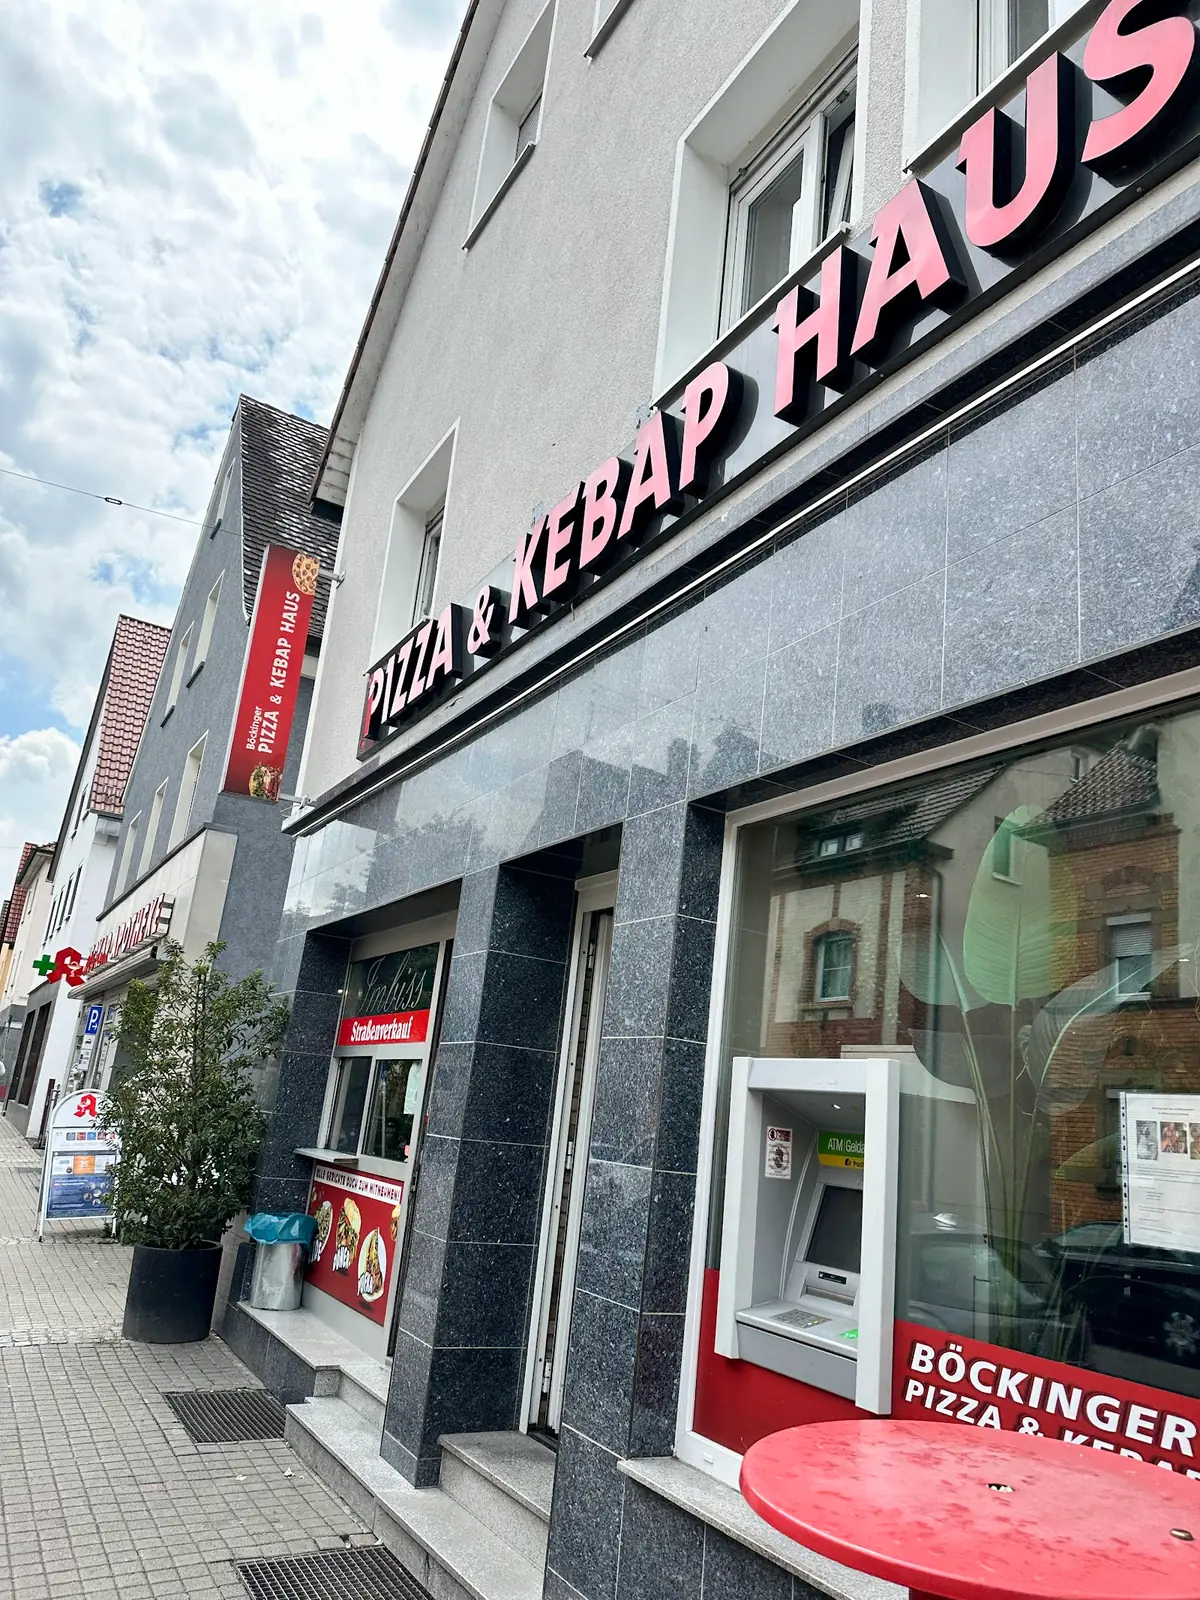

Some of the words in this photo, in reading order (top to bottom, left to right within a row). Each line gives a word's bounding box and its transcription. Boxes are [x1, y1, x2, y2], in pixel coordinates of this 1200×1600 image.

[363, 602, 453, 738] PIZZA
[467, 585, 494, 655] &
[508, 361, 729, 625] KEBAP
[772, 0, 1196, 417] HAUS
[280, 591, 300, 633] HAUS
[270, 637, 292, 688] KEBAP
[270, 694, 282, 705] &
[246, 706, 262, 750] Böckinger
[258, 711, 280, 753] PIZZA
[357, 951, 427, 1015] Imbiss
[350, 1016, 413, 1042] Straßenverkauf
[828, 1137, 843, 1152] ATM
[845, 1139, 865, 1154] Gelda
[905, 1379, 1001, 1430] PIZZA
[910, 1342, 1198, 1458] BÖCKINGER
